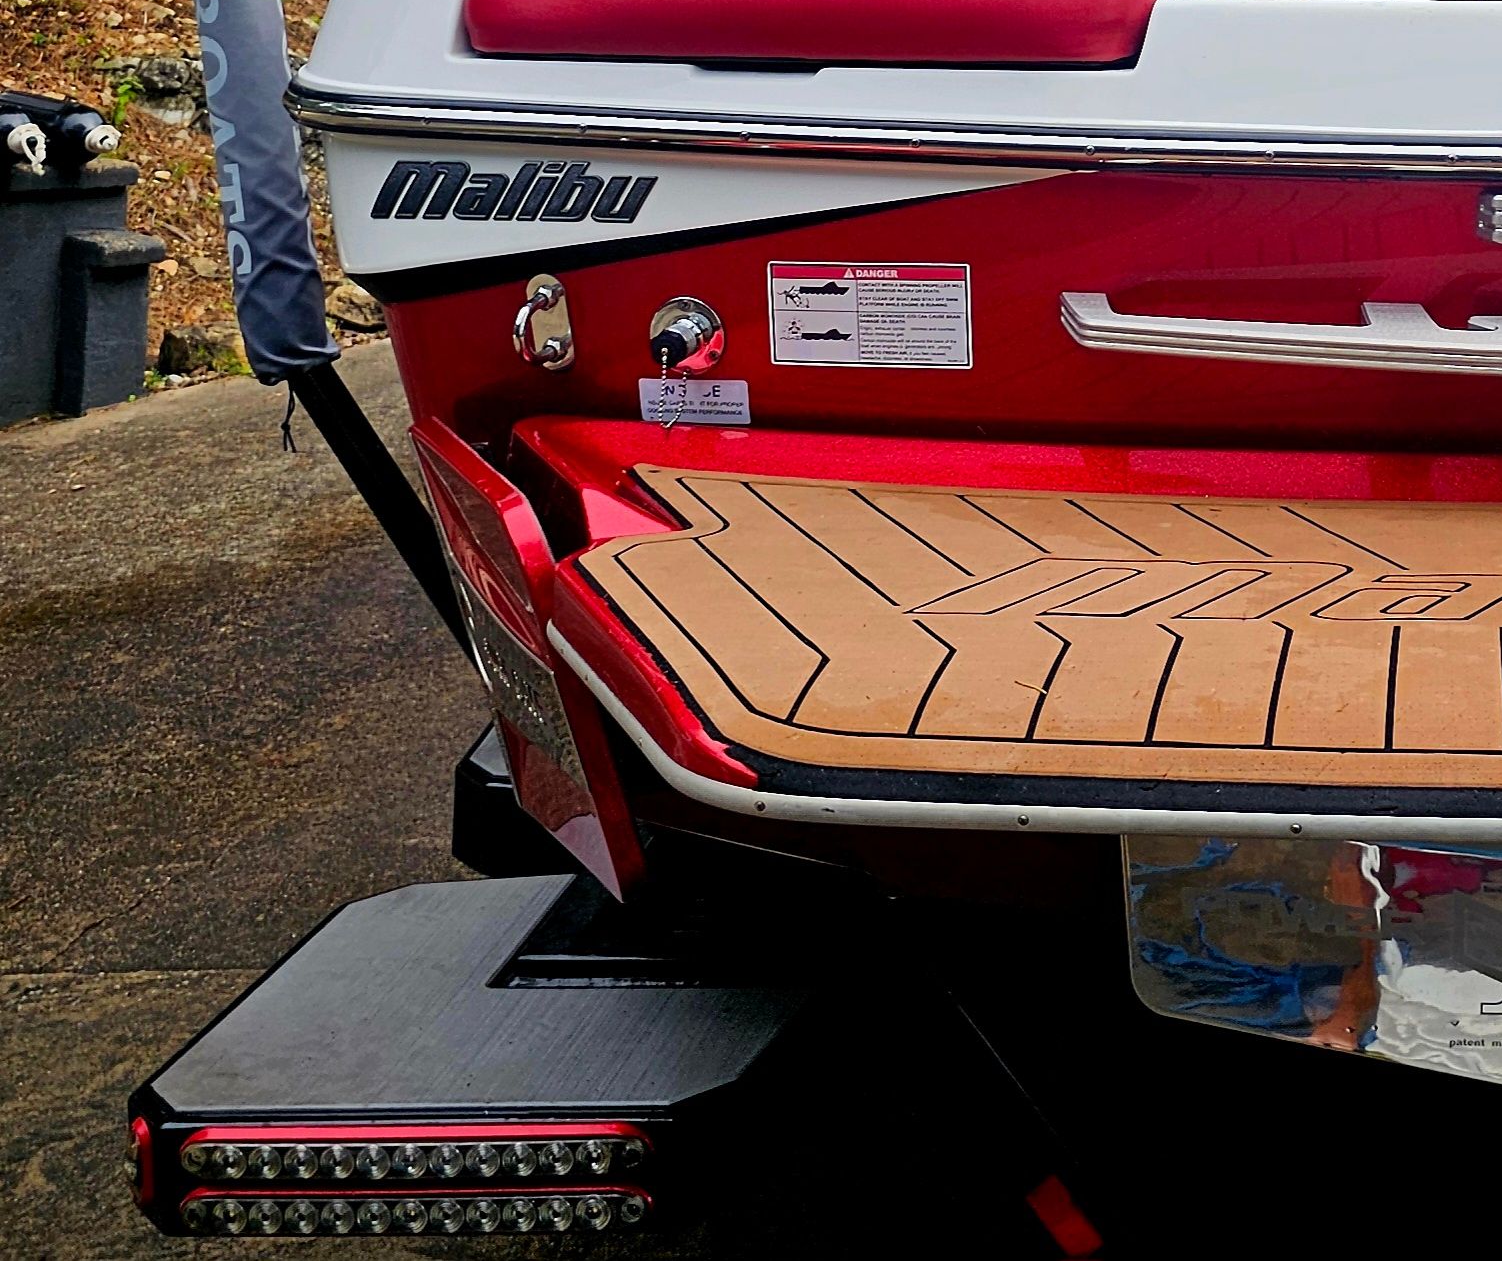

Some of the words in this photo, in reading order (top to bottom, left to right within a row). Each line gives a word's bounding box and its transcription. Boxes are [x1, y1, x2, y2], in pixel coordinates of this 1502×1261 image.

[371, 160, 658, 224] Malibu
[856, 269, 898, 278] DANGER
[1449, 1038, 1486, 1048] patent
